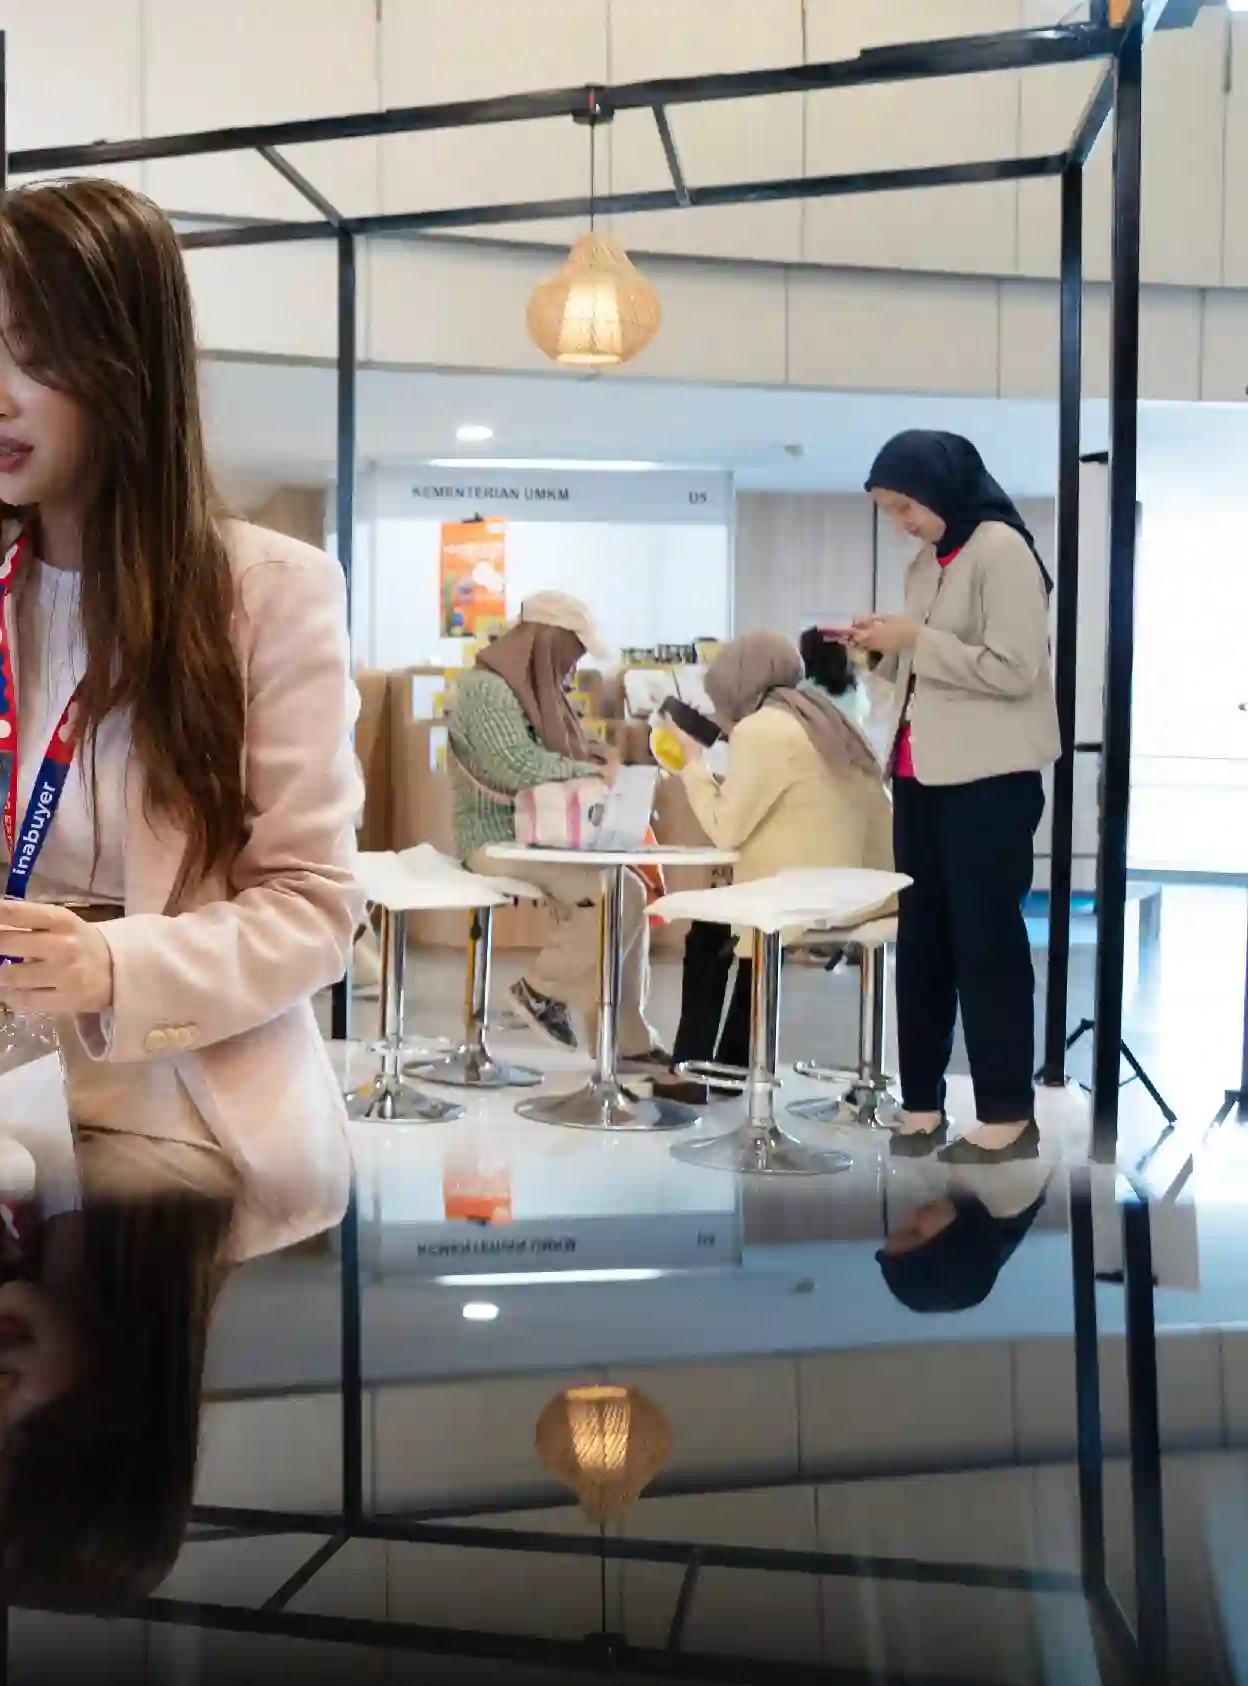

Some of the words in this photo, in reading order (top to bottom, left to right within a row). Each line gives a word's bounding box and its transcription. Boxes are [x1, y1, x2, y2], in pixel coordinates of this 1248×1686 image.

[412, 485, 520, 500] KEMENTERIAN
[524, 486, 570, 501] UMKM
[12, 781, 56, 875] inabuyer
